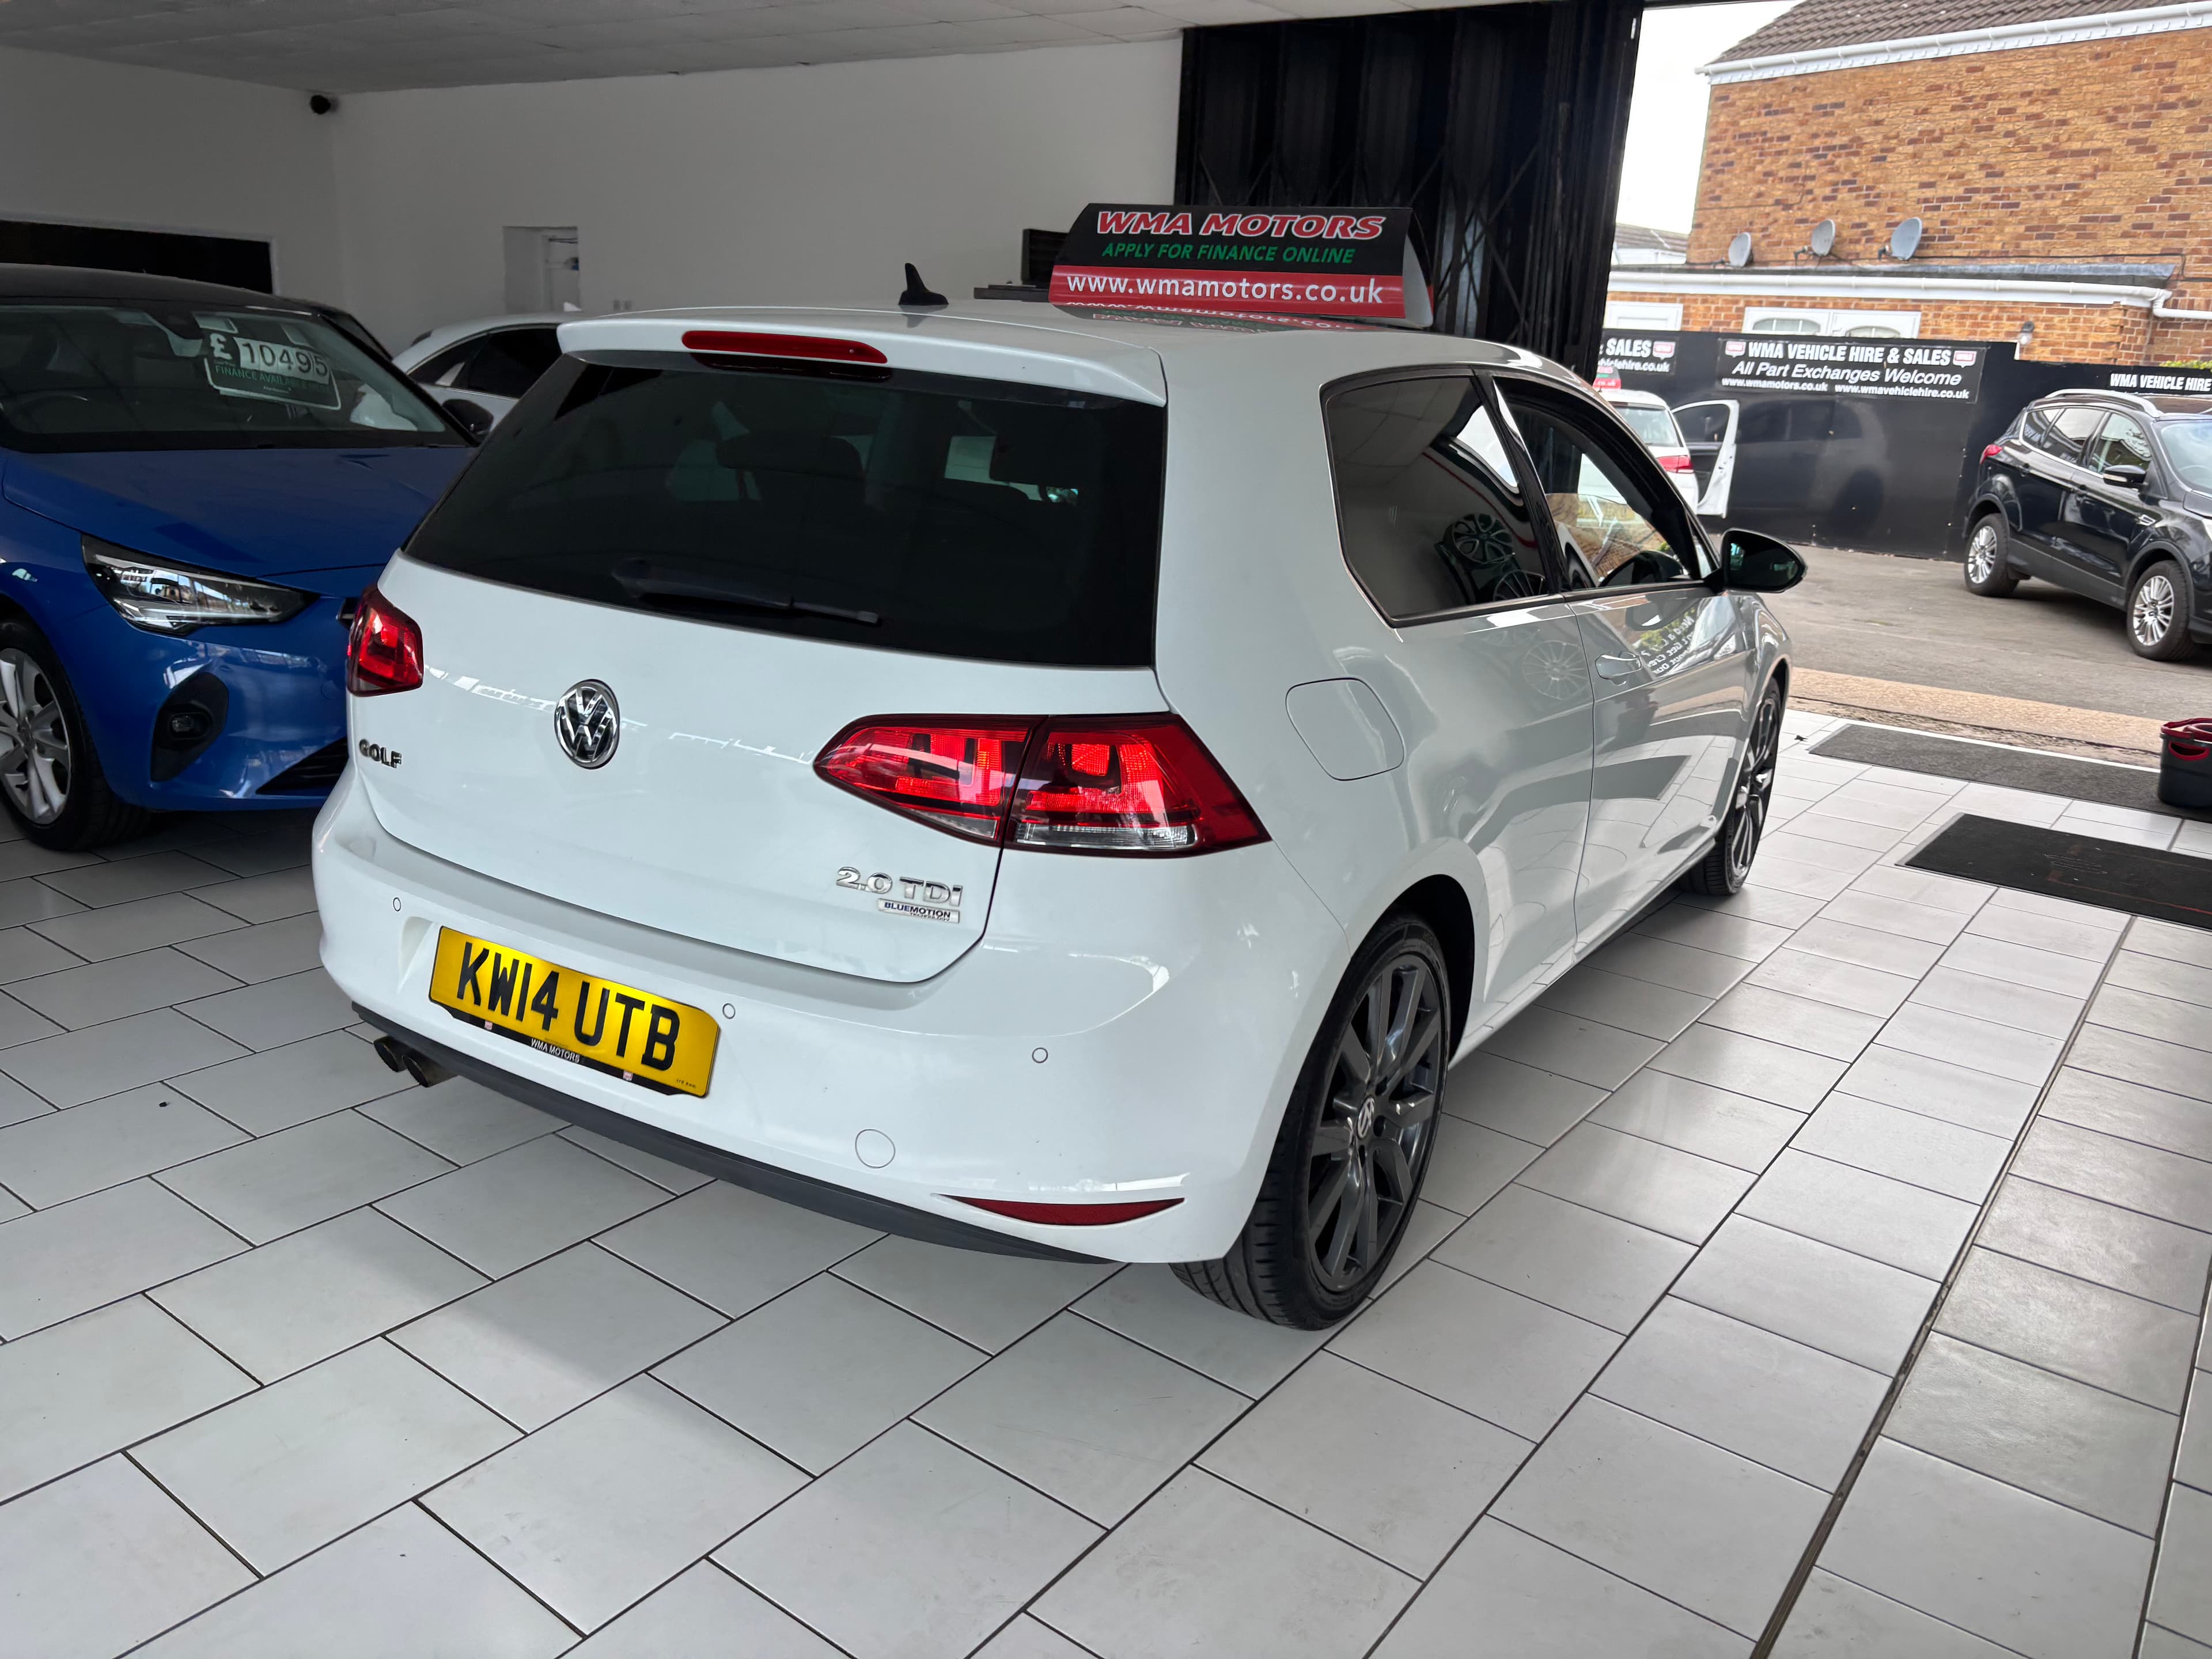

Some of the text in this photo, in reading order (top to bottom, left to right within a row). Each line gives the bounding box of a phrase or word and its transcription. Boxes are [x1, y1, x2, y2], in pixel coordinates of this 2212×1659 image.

[1097, 211, 1386, 240] WMA MOTORS
[1101, 242, 1355, 264] APPLY FOR FINANCE ONLINE
[1067, 274, 1384, 304] www.wmamotors.co.uk
[1605, 338, 1652, 358] SALES
[1748, 342, 1784, 358] WMA
[1787, 343, 1847, 362] VEHICLE
[1849, 346, 1885, 363] HIRE
[1887, 347, 1900, 363] &
[1903, 348, 1952, 366] SALES
[216, 365, 257, 381] FINANCE
[1732, 361, 1962, 386] All Part Exchanges Welcome
[2110, 373, 2212, 392] WMA VEHICLE HIRE
[1722, 377, 1969, 399] www.wmamotors.co.uk www.wmavehiclehire.co.uk
[359, 738, 402, 768] GOLF
[836, 866, 963, 907] 2.0 TDI
[884, 902, 950, 918] BLUEMOTION
[457, 941, 680, 1071] KW14 UTB
[531, 1037, 548, 1052] WMA
[549, 1046, 581, 1063] MOTORS
